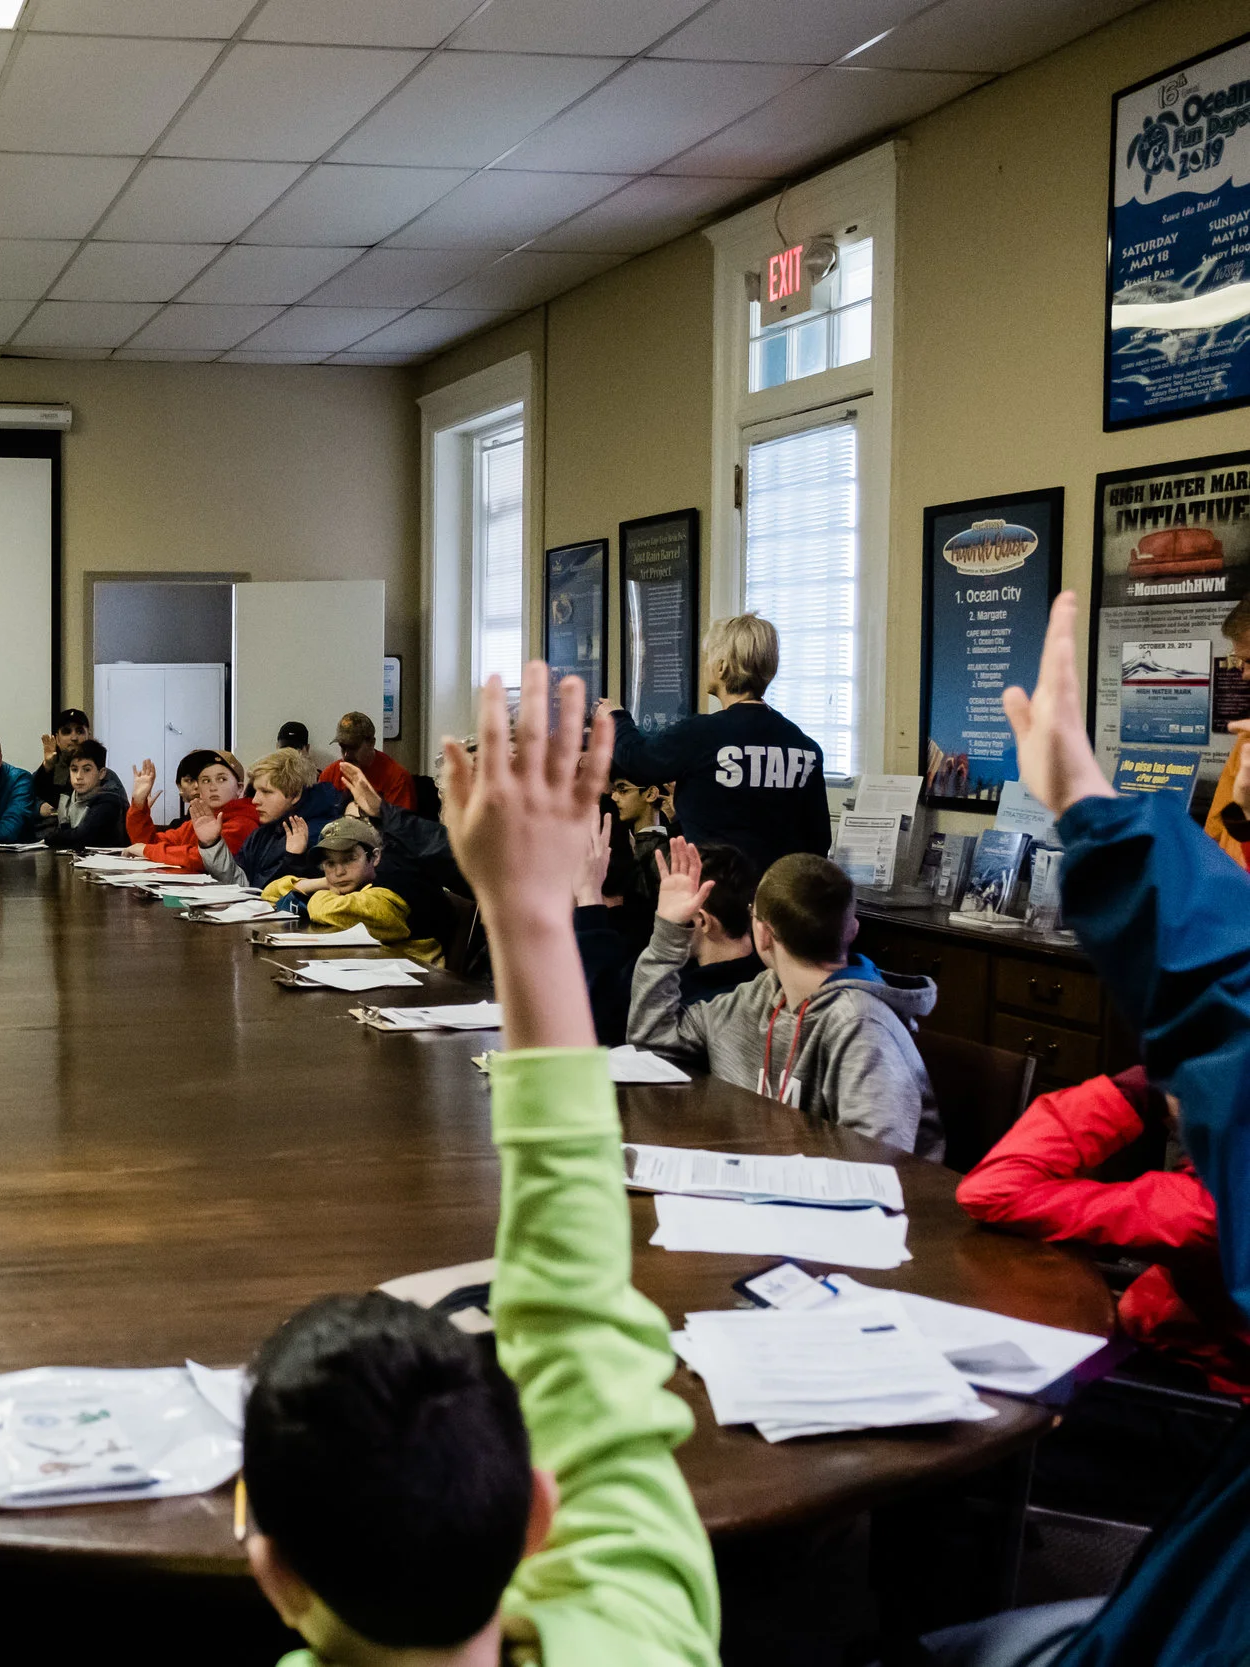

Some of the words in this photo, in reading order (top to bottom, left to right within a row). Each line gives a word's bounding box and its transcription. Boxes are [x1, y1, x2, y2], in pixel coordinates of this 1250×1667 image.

[1182, 79, 1250, 126] Ocean
[1172, 125, 1204, 154] Fun
[1177, 137, 1225, 181] 2019
[1208, 209, 1250, 232] SUNDAY
[1121, 231, 1179, 260] SATURDAY
[1211, 230, 1235, 246] MAY
[1237, 225, 1249, 238] 19
[769, 244, 803, 302] EXIT
[1130, 253, 1155, 272] MAY
[1157, 250, 1170, 263] 18
[1110, 485, 1144, 506] HIGH
[1150, 477, 1205, 501] WATER
[1210, 469, 1250, 494] MAR
[1116, 495, 1250, 532] INITIATIVE
[646, 551, 660, 563] Rain
[661, 545, 680, 560] Barrel
[650, 565, 671, 580] Project
[955, 590, 964, 604] 1.
[966, 589, 999, 603] Ocean
[1001, 585, 1021, 602] City
[1126, 577, 1226, 597] #MonmouthHWM
[977, 609, 1007, 621] Margate
[716, 746, 817, 788] STAFF
